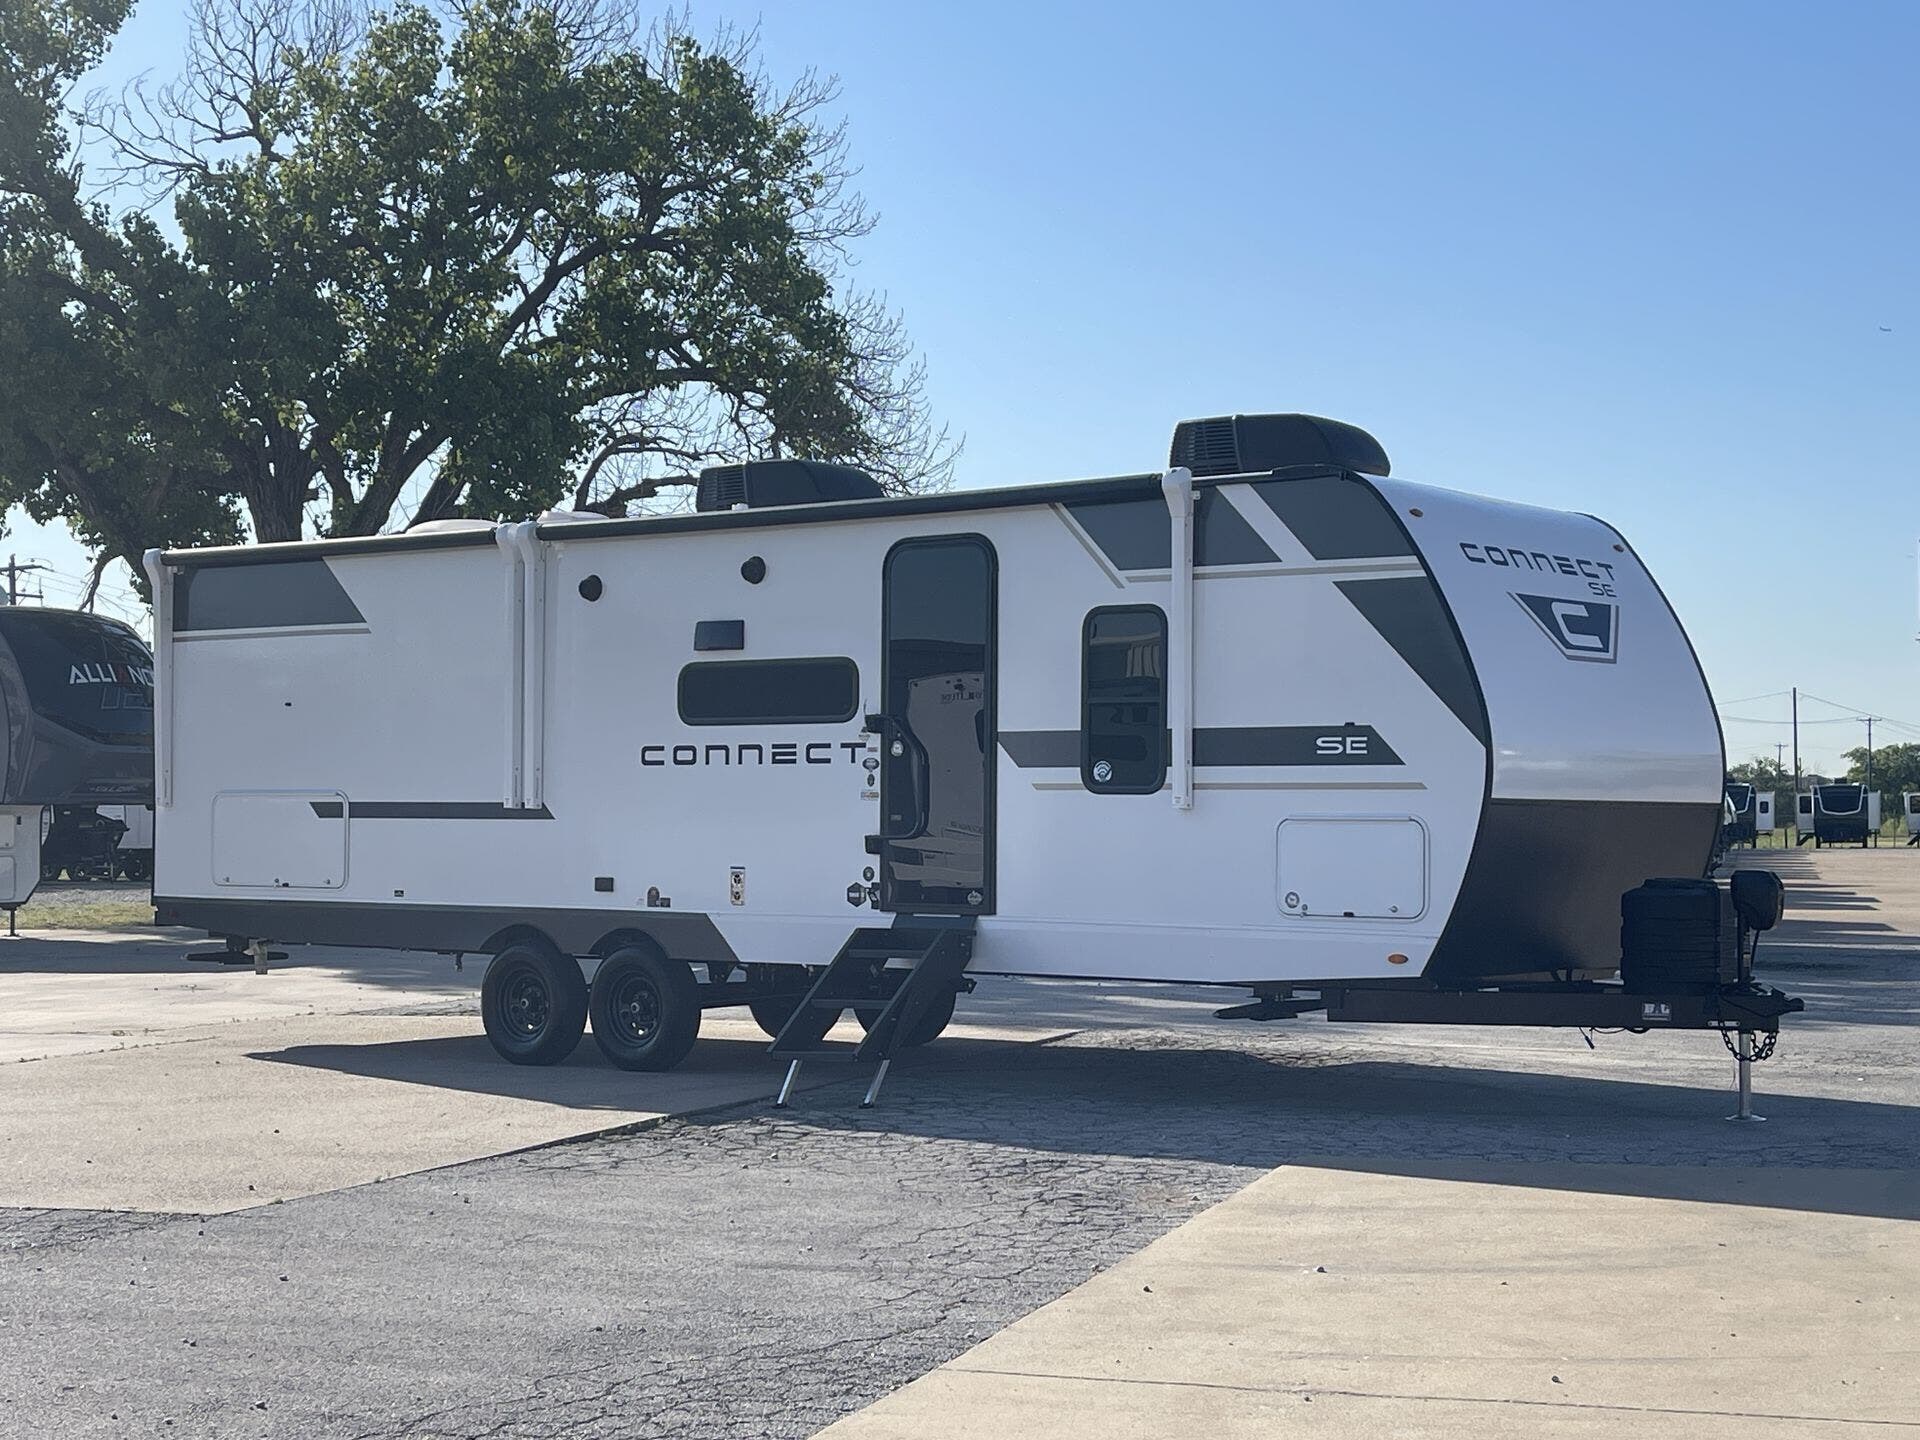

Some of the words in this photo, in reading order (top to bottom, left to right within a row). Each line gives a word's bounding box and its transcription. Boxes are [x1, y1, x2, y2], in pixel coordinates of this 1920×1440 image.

[1459, 542, 1615, 581] CONNECT
[1588, 582, 1617, 598] SE
[641, 742, 867, 766] CONNECT
[1315, 736, 1368, 755] SE
